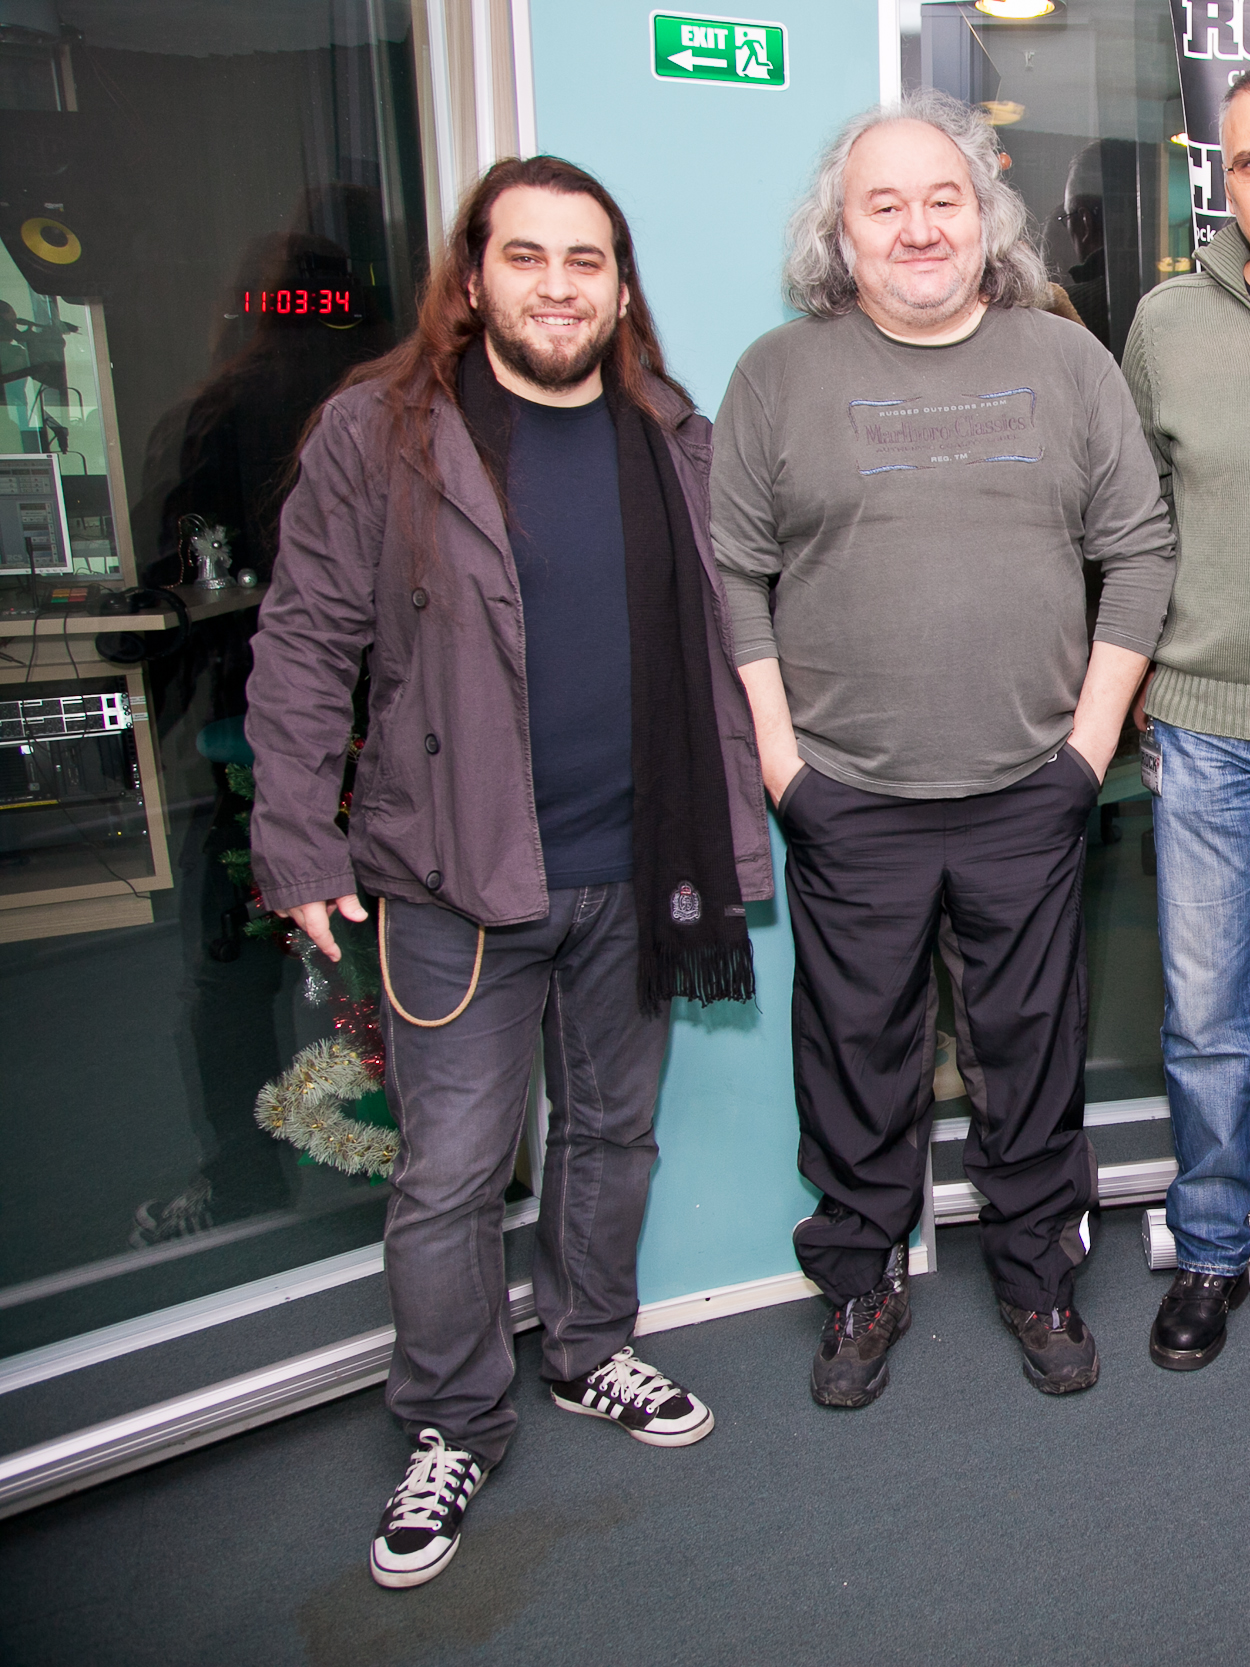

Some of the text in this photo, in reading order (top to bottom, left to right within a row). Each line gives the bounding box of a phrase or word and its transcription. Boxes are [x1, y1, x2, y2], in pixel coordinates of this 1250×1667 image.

[681, 24, 728, 50] EXIT
[879, 400, 1007, 417] RUGGED OUTDOORS FROM
[865, 421, 950, 446] Marlboro
[954, 415, 1026, 439] Classics
[930, 454, 952, 463] REG.
